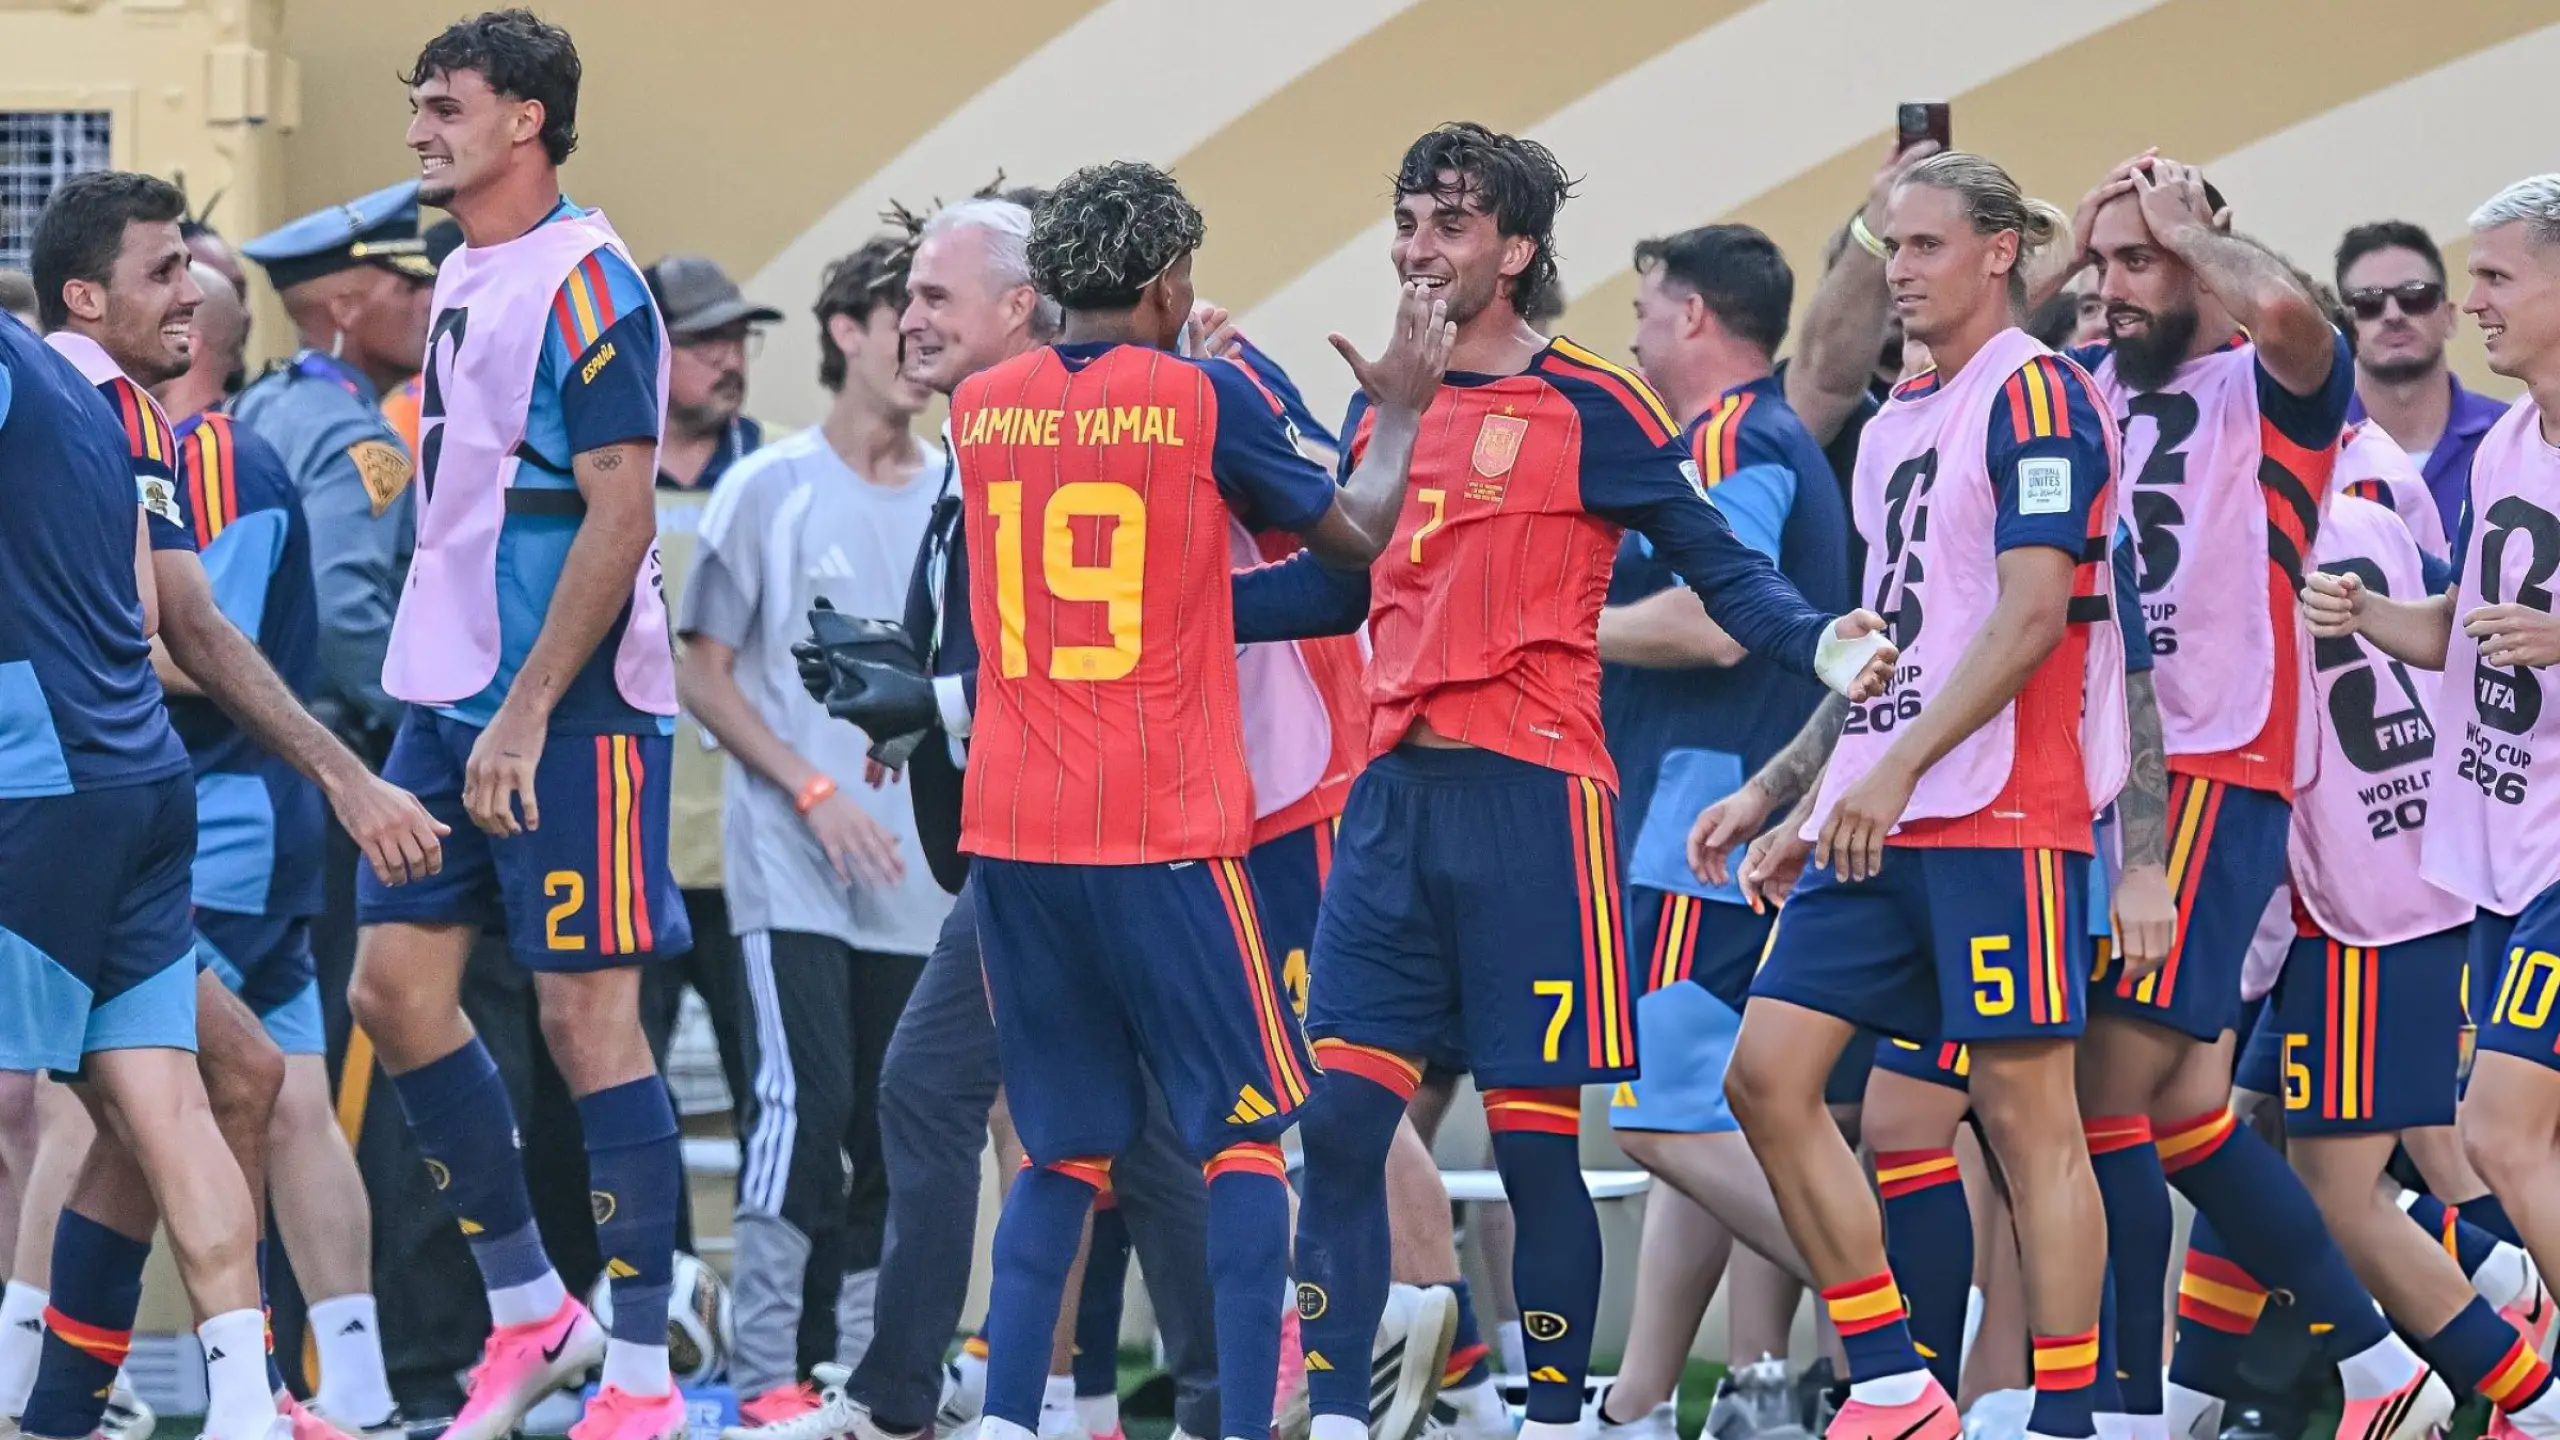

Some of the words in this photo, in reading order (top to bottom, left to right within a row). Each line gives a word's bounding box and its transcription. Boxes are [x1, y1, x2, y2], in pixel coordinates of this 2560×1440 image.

[581, 342, 616, 385] ESPAÑA
[960, 407, 1065, 447] LAMINE
[1074, 405, 1184, 447] YAMAL
[2028, 476, 2061, 488] UNITES
[1410, 488, 1446, 563] 7
[987, 480, 1147, 681] 19
[1894, 665, 1923, 686] UP
[2479, 676, 2516, 714] IFA
[1842, 689, 1923, 736] 206
[2375, 717, 2432, 752] FIFA
[2495, 743, 2532, 770] CUP
[2367, 798, 2428, 841] 20
[543, 870, 586, 951] 2
[1969, 935, 2015, 1017] 5
[2490, 946, 2560, 1030] 10
[1533, 980, 1574, 1063] 7
